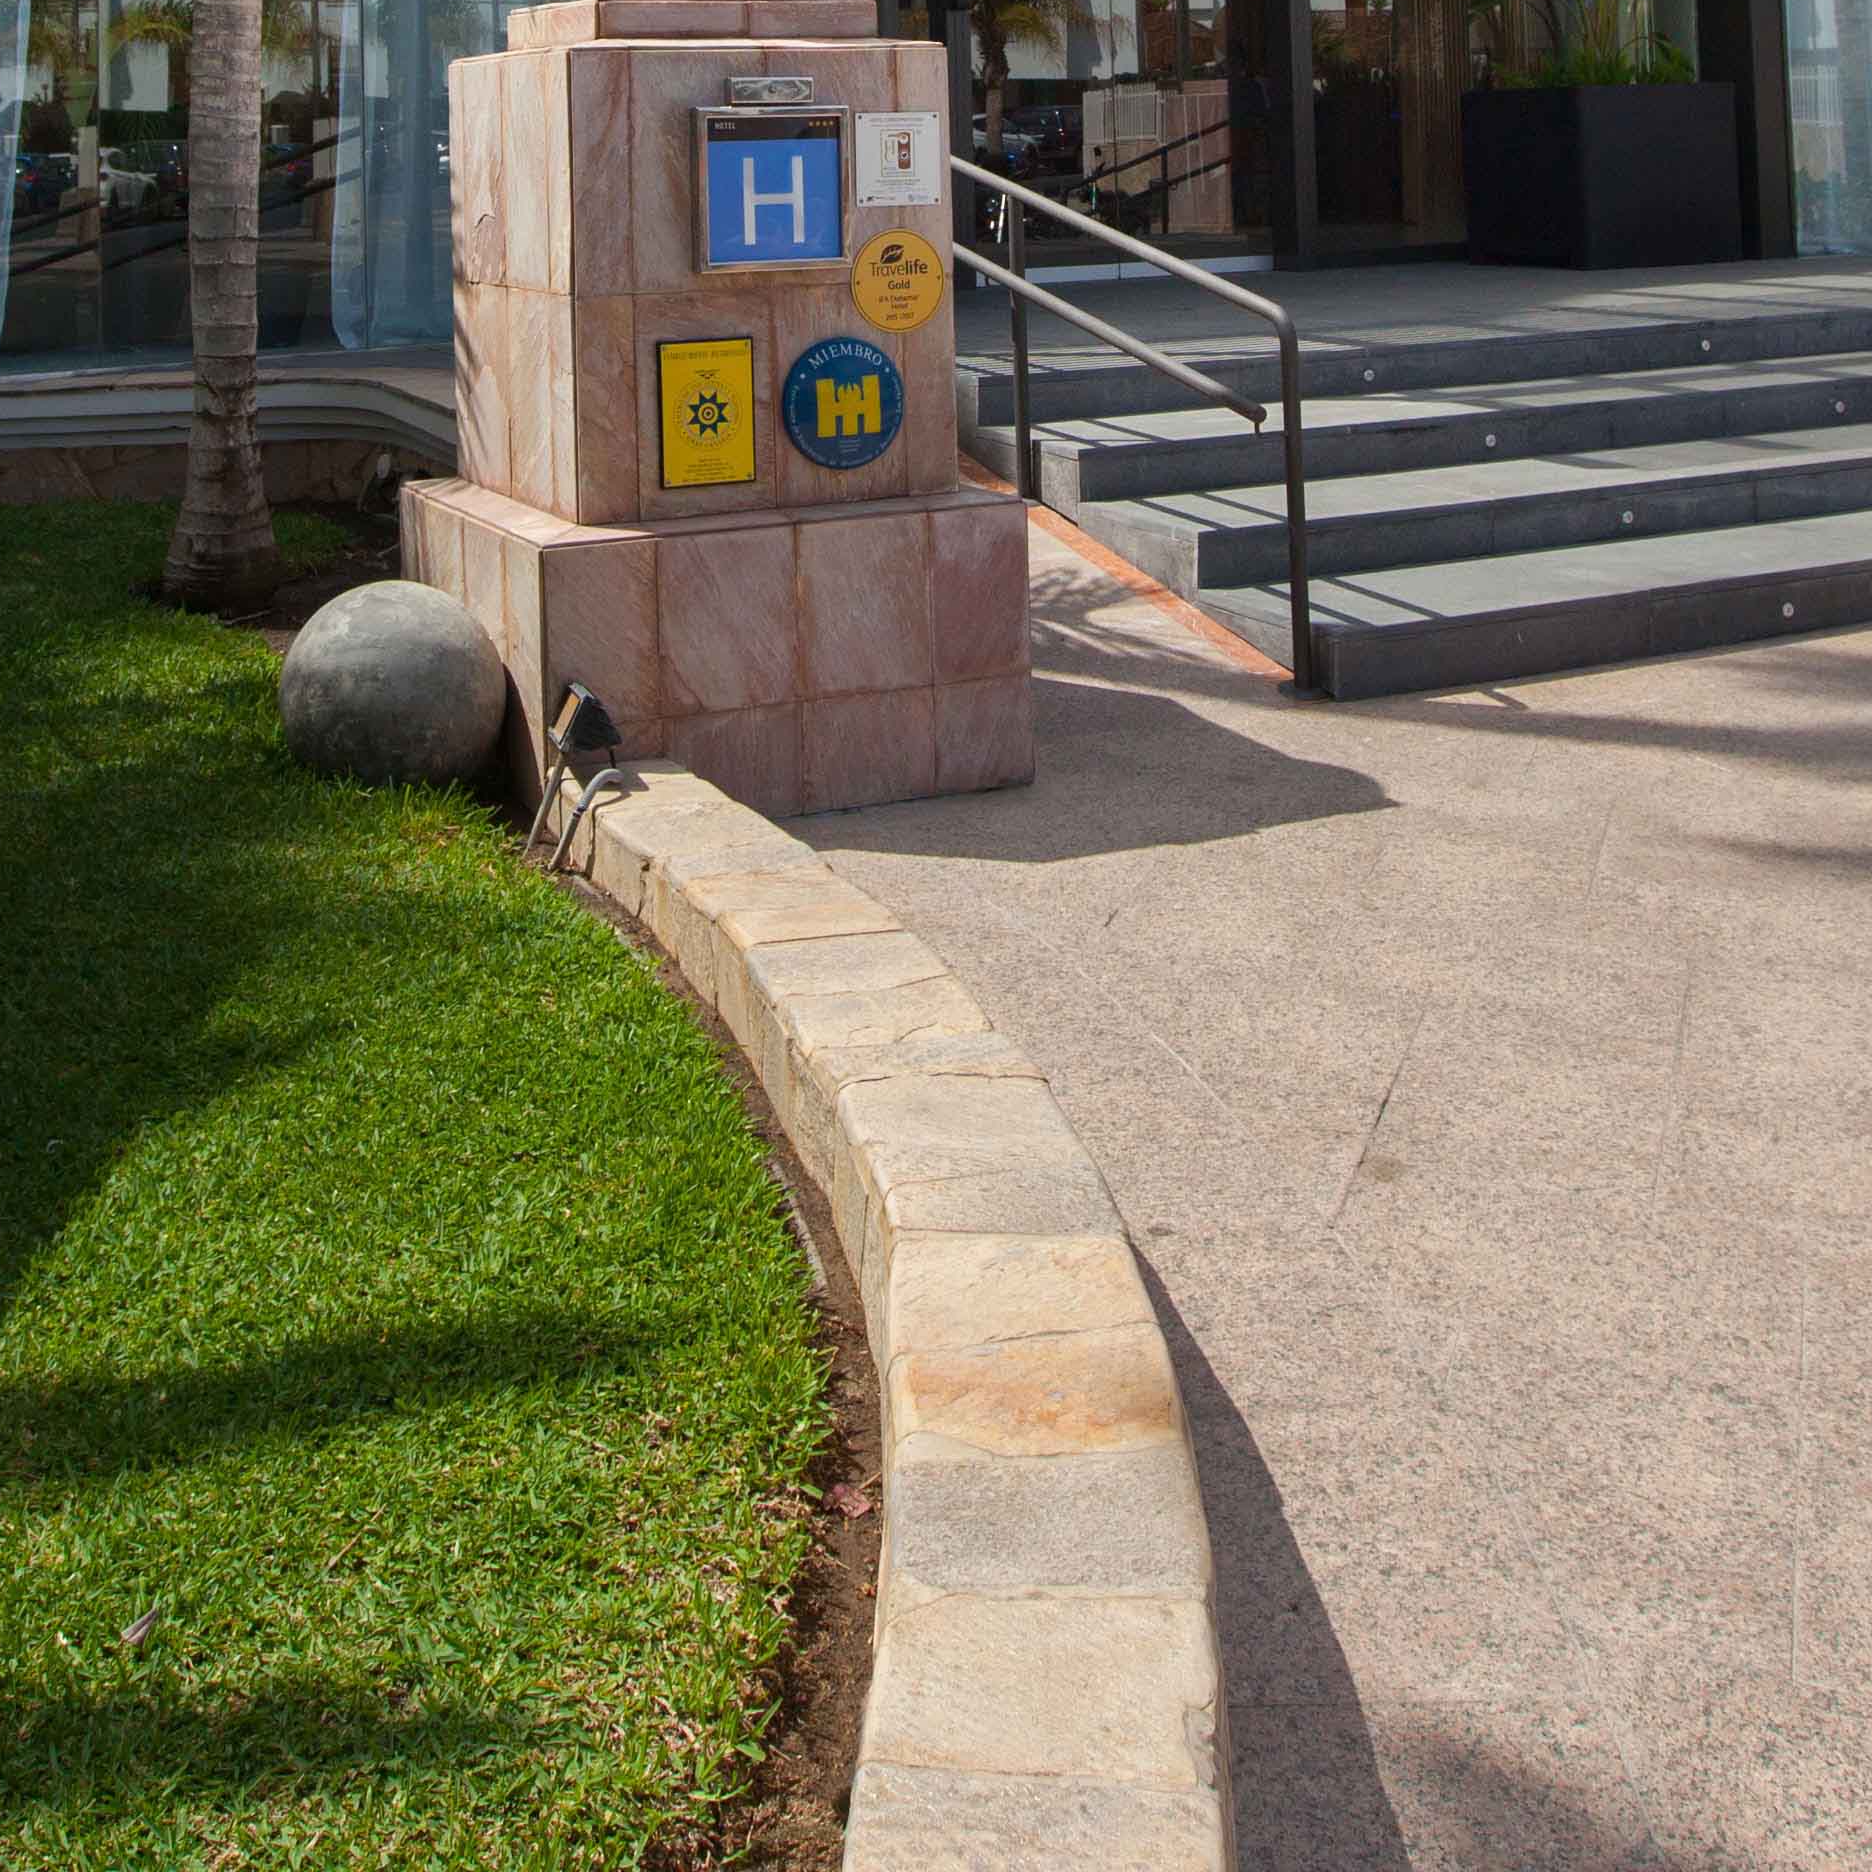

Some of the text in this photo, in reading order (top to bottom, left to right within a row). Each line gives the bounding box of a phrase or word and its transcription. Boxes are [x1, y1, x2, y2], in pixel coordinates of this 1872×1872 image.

[742, 155, 805, 245] H
[869, 258, 929, 277] Travelife
[887, 280, 911, 290] Gold
[808, 342, 883, 369] MIEMBRO
